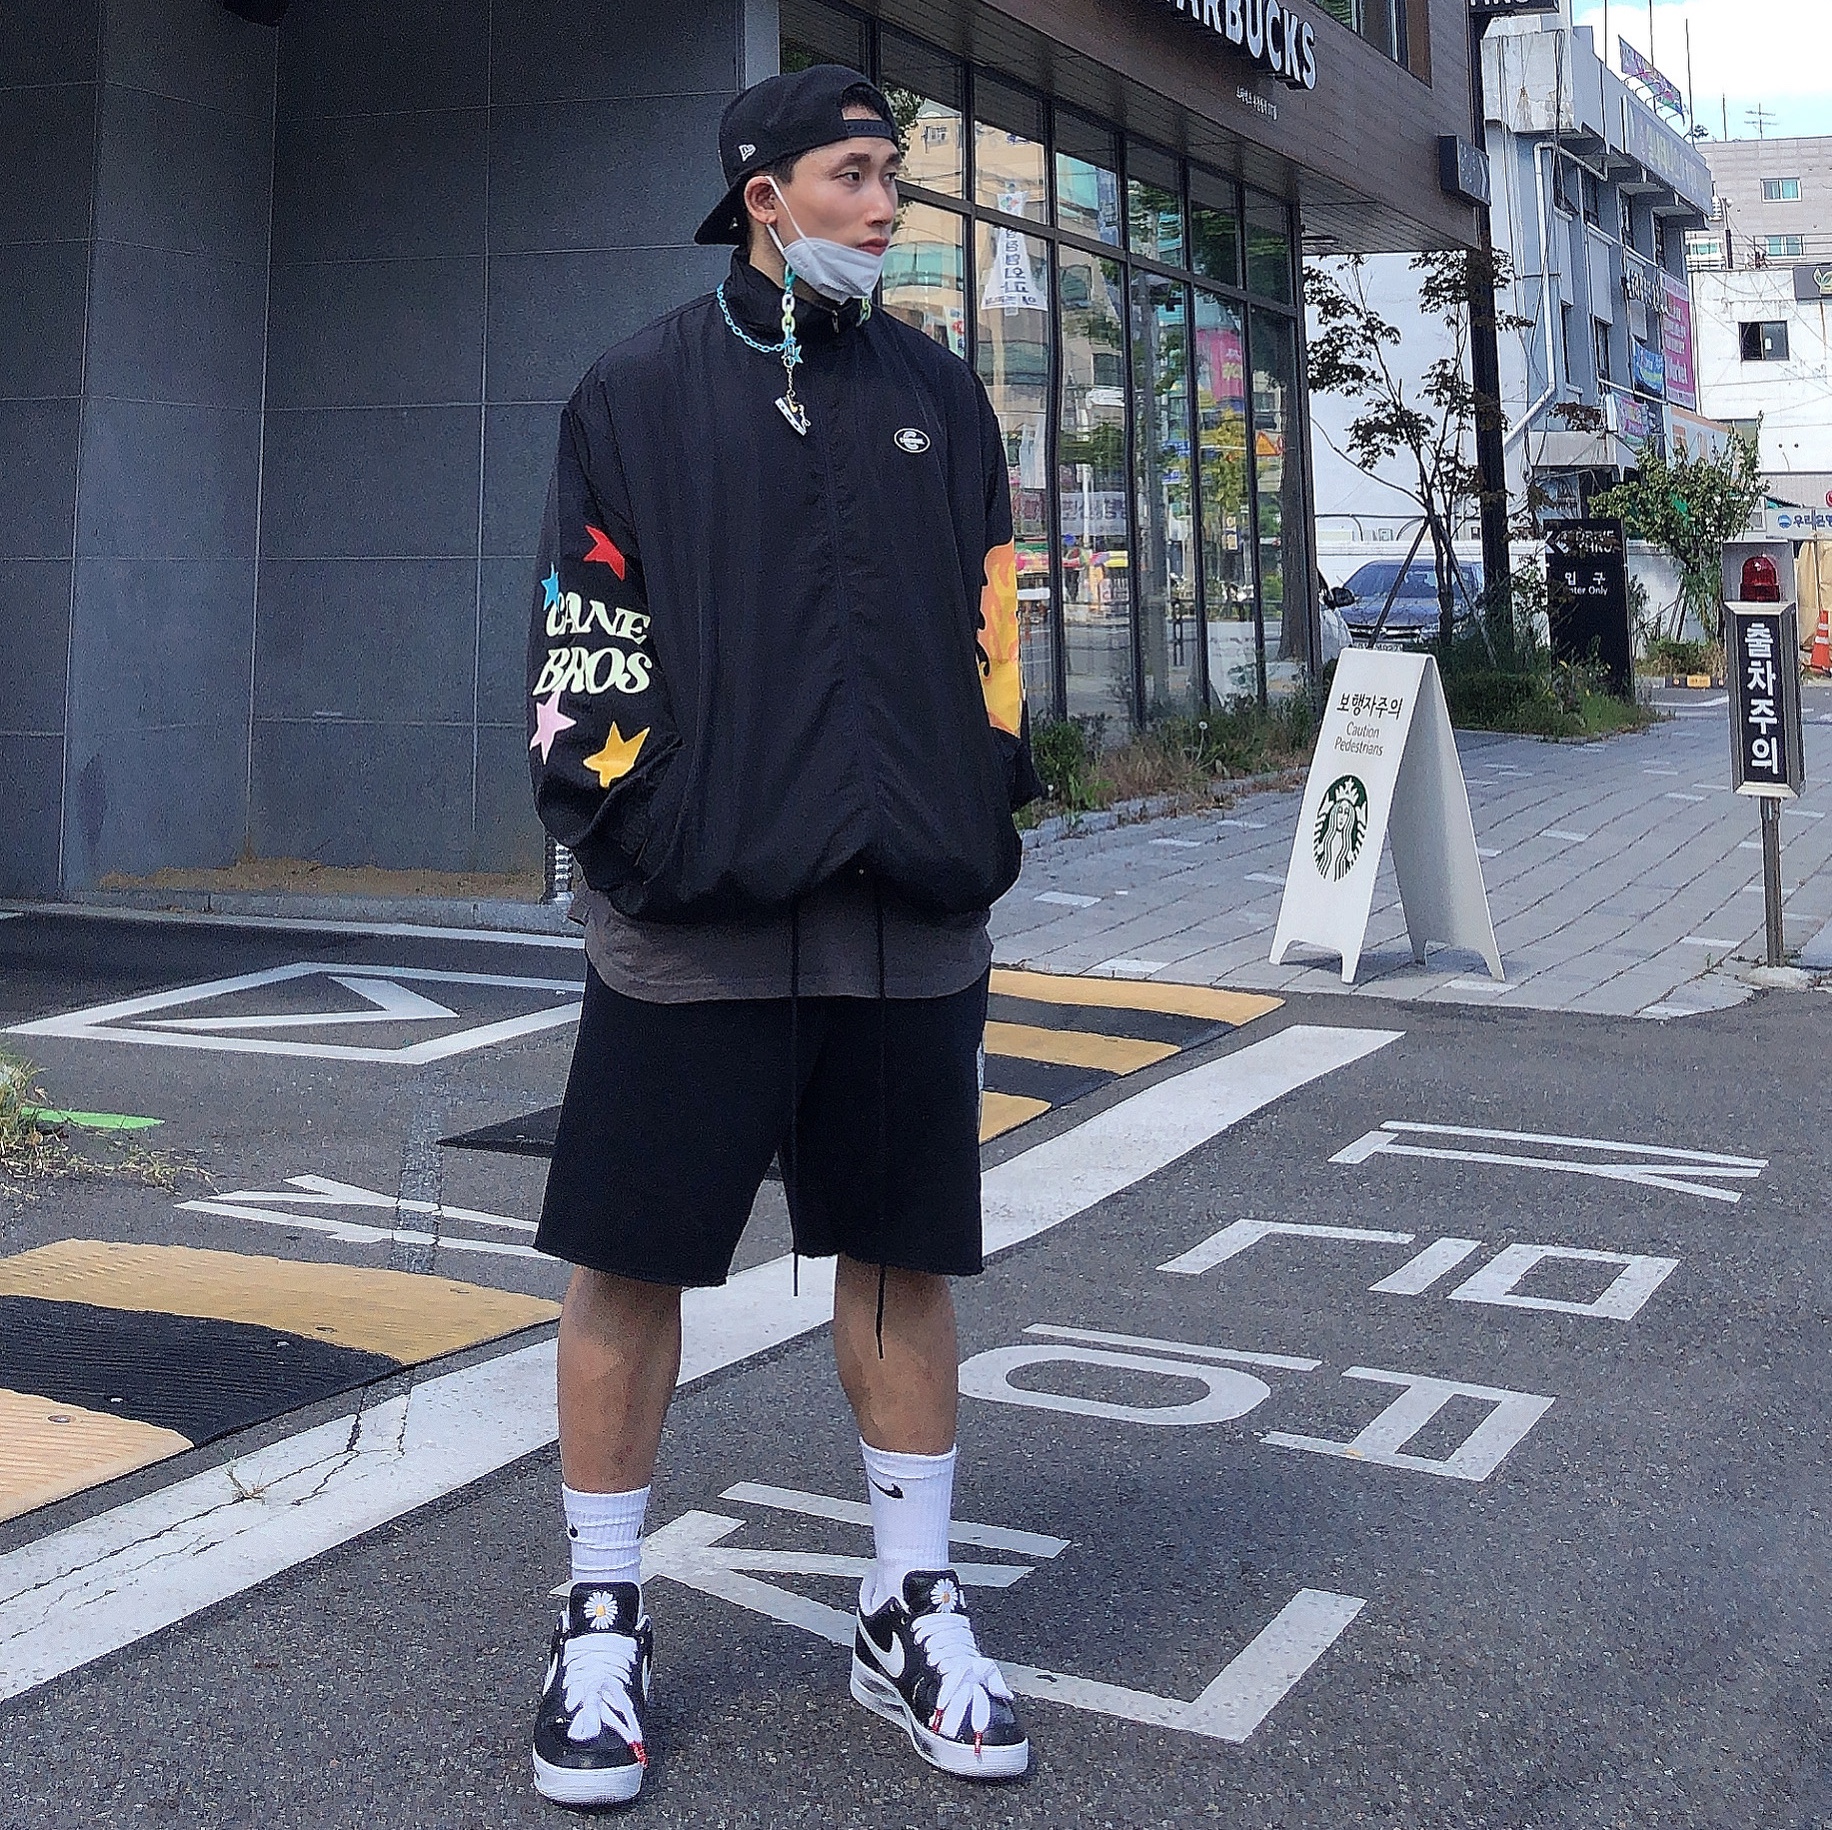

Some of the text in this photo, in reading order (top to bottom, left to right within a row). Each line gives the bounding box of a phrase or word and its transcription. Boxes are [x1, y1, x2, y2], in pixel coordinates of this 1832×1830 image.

[1175, 0, 1317, 90] BUCKS
[1569, 585, 1608, 596] nter Only
[546, 592, 651, 644] CANE
[532, 646, 653, 696] BROS
[1336, 693, 1403, 720] 보행자주의
[1744, 622, 1780, 775] 출차주의
[1334, 736, 1383, 756] Pedestrians
[1346, 721, 1380, 738] Caution
